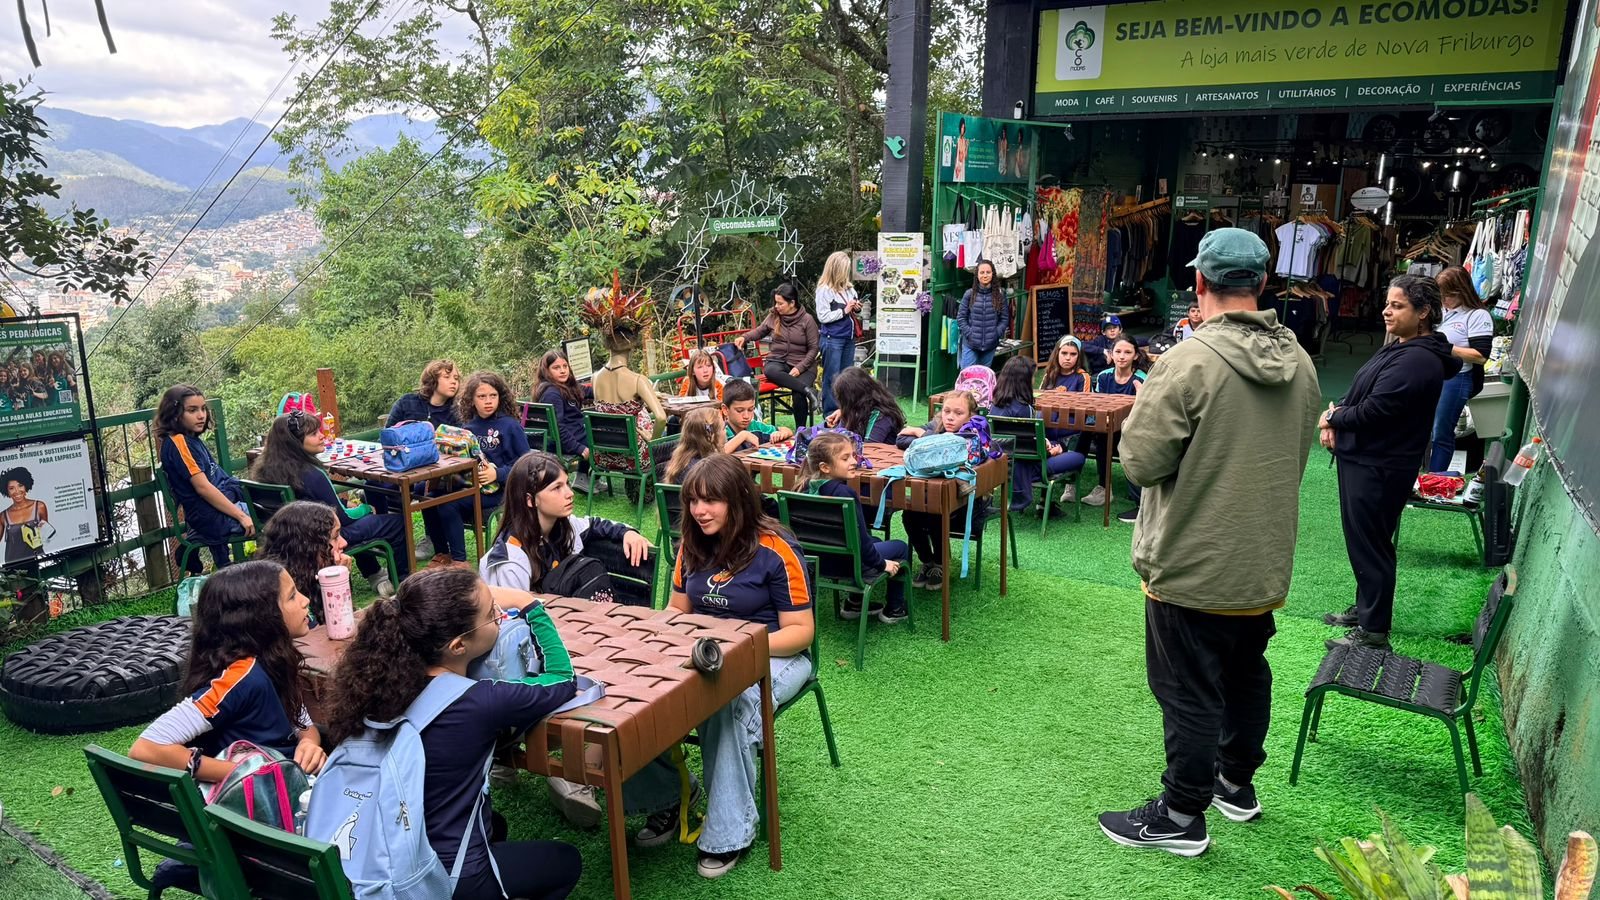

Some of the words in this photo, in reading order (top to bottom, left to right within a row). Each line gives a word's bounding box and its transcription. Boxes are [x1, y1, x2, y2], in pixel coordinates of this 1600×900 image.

[1115, 20, 1166, 42] SEJA
[1174, 8, 1322, 38] BEM-VINDO
[1329, 6, 1349, 27] A
[1359, 0, 1538, 25] ECOMODAS!
[1181, 51, 1193, 68] A
[1200, 48, 1228, 70] loja
[1236, 45, 1277, 64] mais
[1284, 40, 1338, 62] verde
[1344, 38, 1367, 57] de
[1376, 39, 1429, 56] Nova
[1438, 32, 1534, 57] Friburgo
[1055, 98, 1079, 107] MODA
[1095, 95, 1115, 105] CAFÉ
[1131, 94, 1178, 104] SOUVENIRS
[1195, 91, 1259, 101] ARTESANATOS
[1278, 87, 1337, 99] UTILITÁRIOS
[1358, 83, 1421, 96] DECORAÇÃO
[1443, 81, 1521, 92] EXPERIÊNCIAS
[713, 218, 777, 232] @ecomodas.oficial
[9, 327, 62, 339] PEDAGÓGICAS
[10, 414, 24, 422] PARA
[25, 411, 42, 419] AULAS
[43, 407, 73, 417] EDUCATIVAS
[20, 450, 44, 458] BRINDES
[45, 444, 81, 455] SUSTENTÁVEIS
[39, 456, 54, 464] PARA
[55, 452, 82, 460] EMPRESAS
